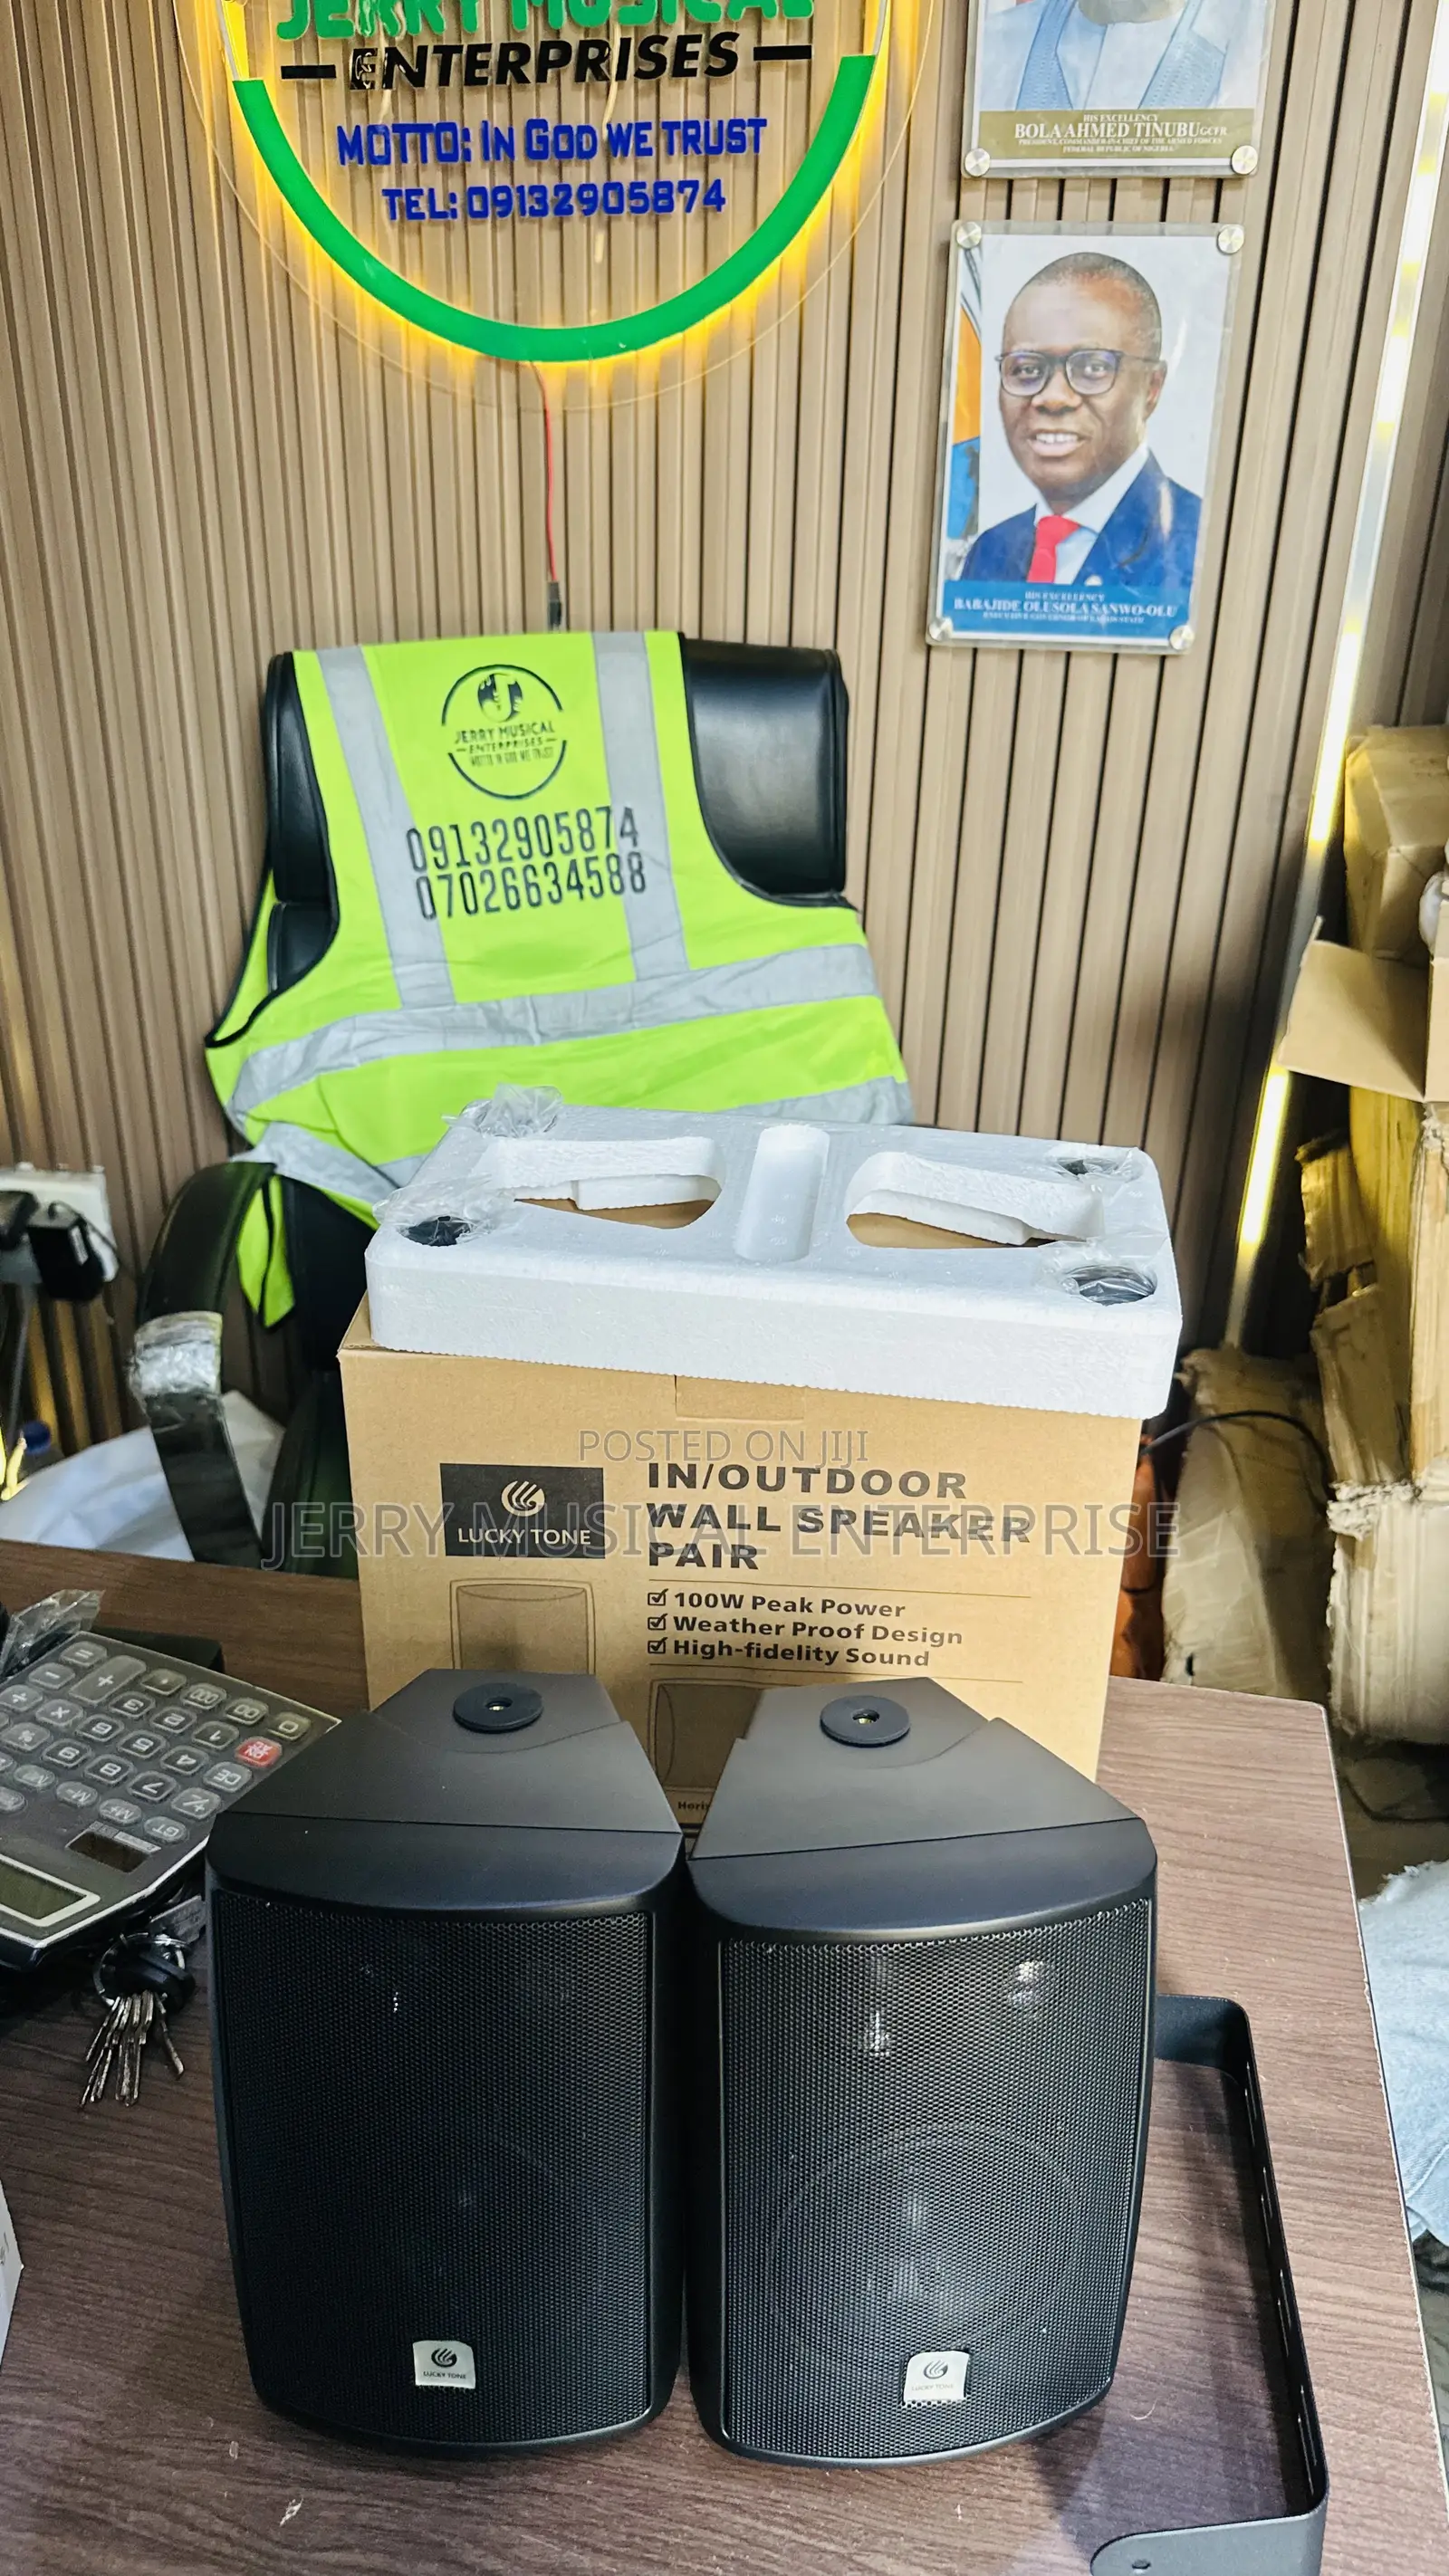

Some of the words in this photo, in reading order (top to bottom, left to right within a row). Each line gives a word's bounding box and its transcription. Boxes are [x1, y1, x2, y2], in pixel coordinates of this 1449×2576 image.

[350, 32, 740, 91] ENTERPRISES
[1014, 122, 1061, 139] BOLA
[1063, 122, 1130, 139] AHMED
[1134, 121, 1201, 138] TINUBU
[1083, 113, 1099, 123] HIS
[1100, 113, 1159, 123] EXCELLENCY
[336, 121, 472, 166] MOTTO:
[606, 120, 653, 158] WE
[661, 118, 768, 156] TRUST
[381, 187, 458, 221] TEL:
[466, 178, 726, 218] 09132905874
[455, 728, 494, 745] JERRY
[498, 721, 555, 739] MUSICAL
[406, 805, 639, 873] 09132905874
[416, 851, 647, 921] 07026634588
[648, 1462, 966, 1499] IN/OUTDOOR
[457, 1527, 525, 1545] LUCKY
[530, 1528, 591, 1546] TONE
[646, 1503, 782, 1532] WALL
[797, 1508, 1031, 1543] SPEAKER
[648, 1542, 759, 1570] PAIR
[675, 1592, 744, 1609] 100W
[752, 1595, 813, 1614] Peak
[821, 1599, 906, 1617] Power
[673, 1616, 785, 1635] Weather
[792, 1622, 865, 1640] Proof
[872, 1625, 963, 1648] Design
[674, 1640, 840, 1666] High-fidelity
[846, 1648, 929, 1666] Sound
